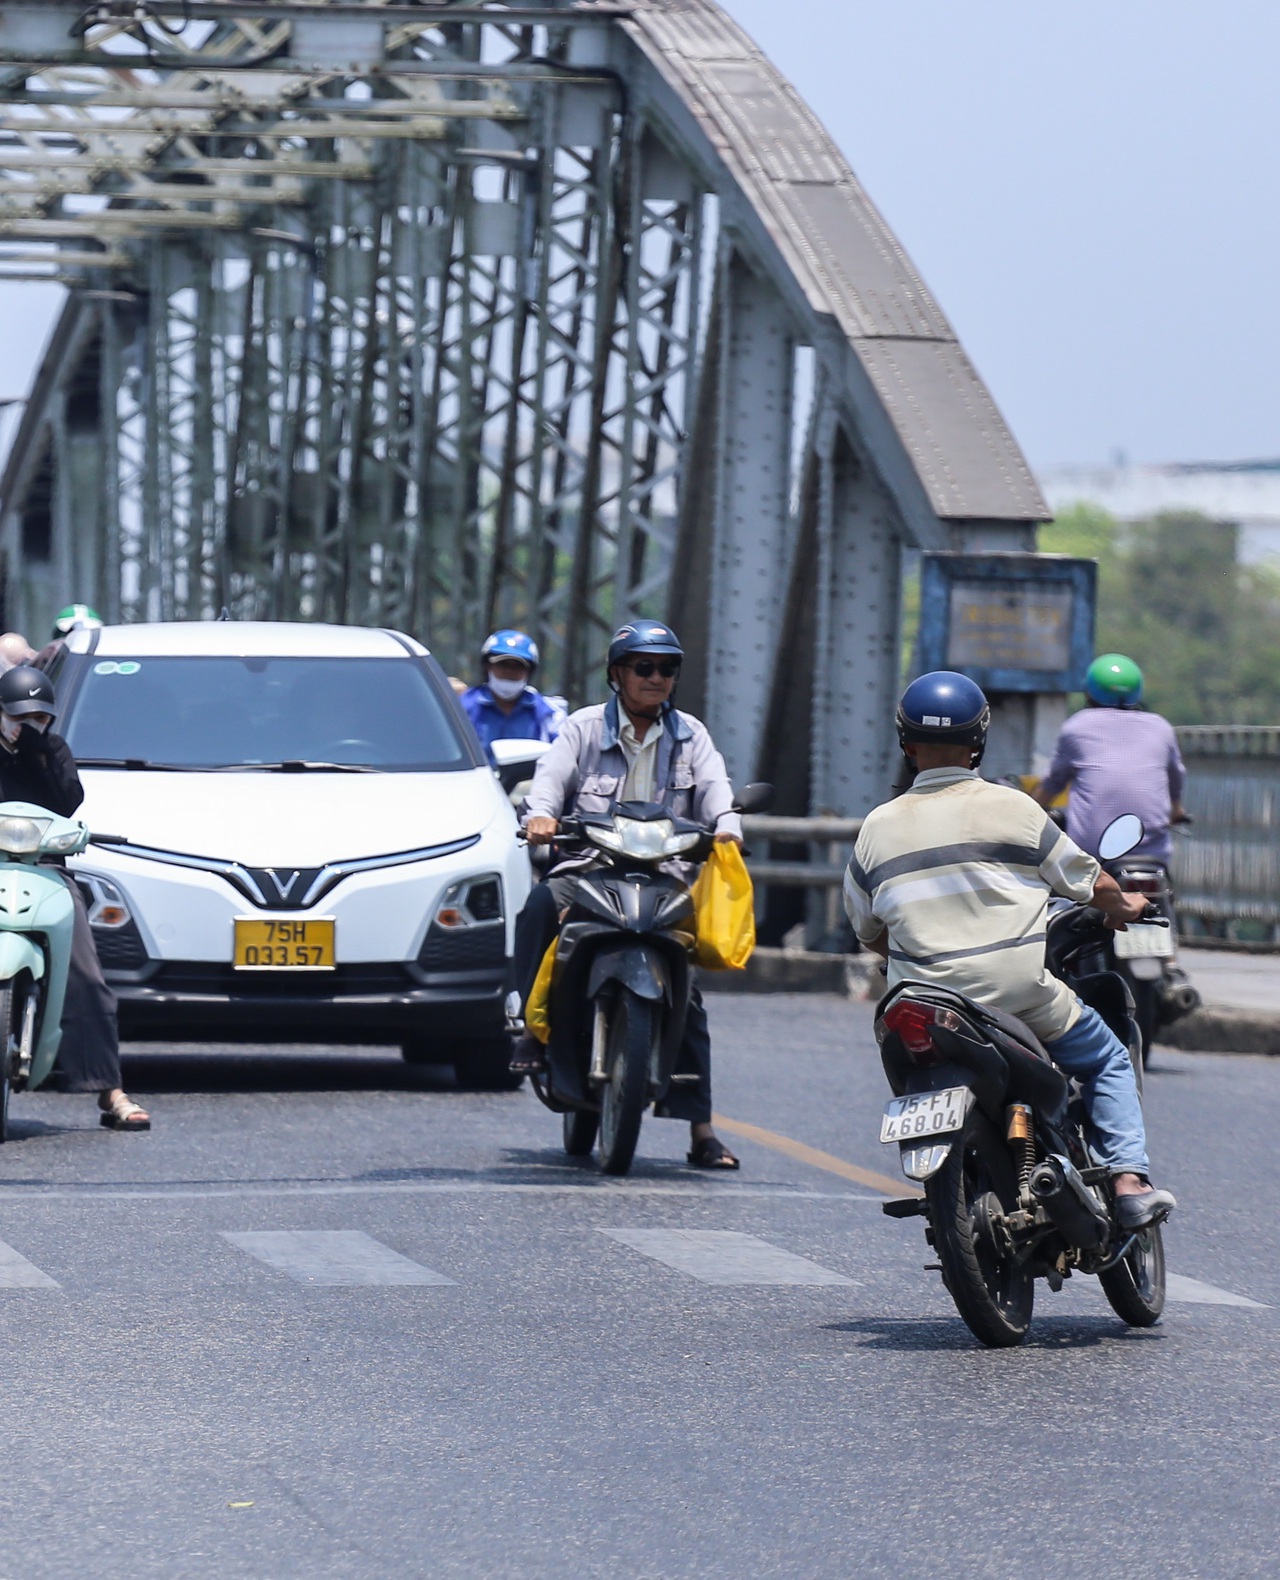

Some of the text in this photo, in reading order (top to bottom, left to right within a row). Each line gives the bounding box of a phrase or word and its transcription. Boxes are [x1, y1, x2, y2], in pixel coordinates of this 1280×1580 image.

[263, 921, 306, 942] 75H
[245, 945, 324, 966] 033.57
[898, 1090, 953, 1117] 75-F1
[886, 1109, 958, 1138] 468.04
